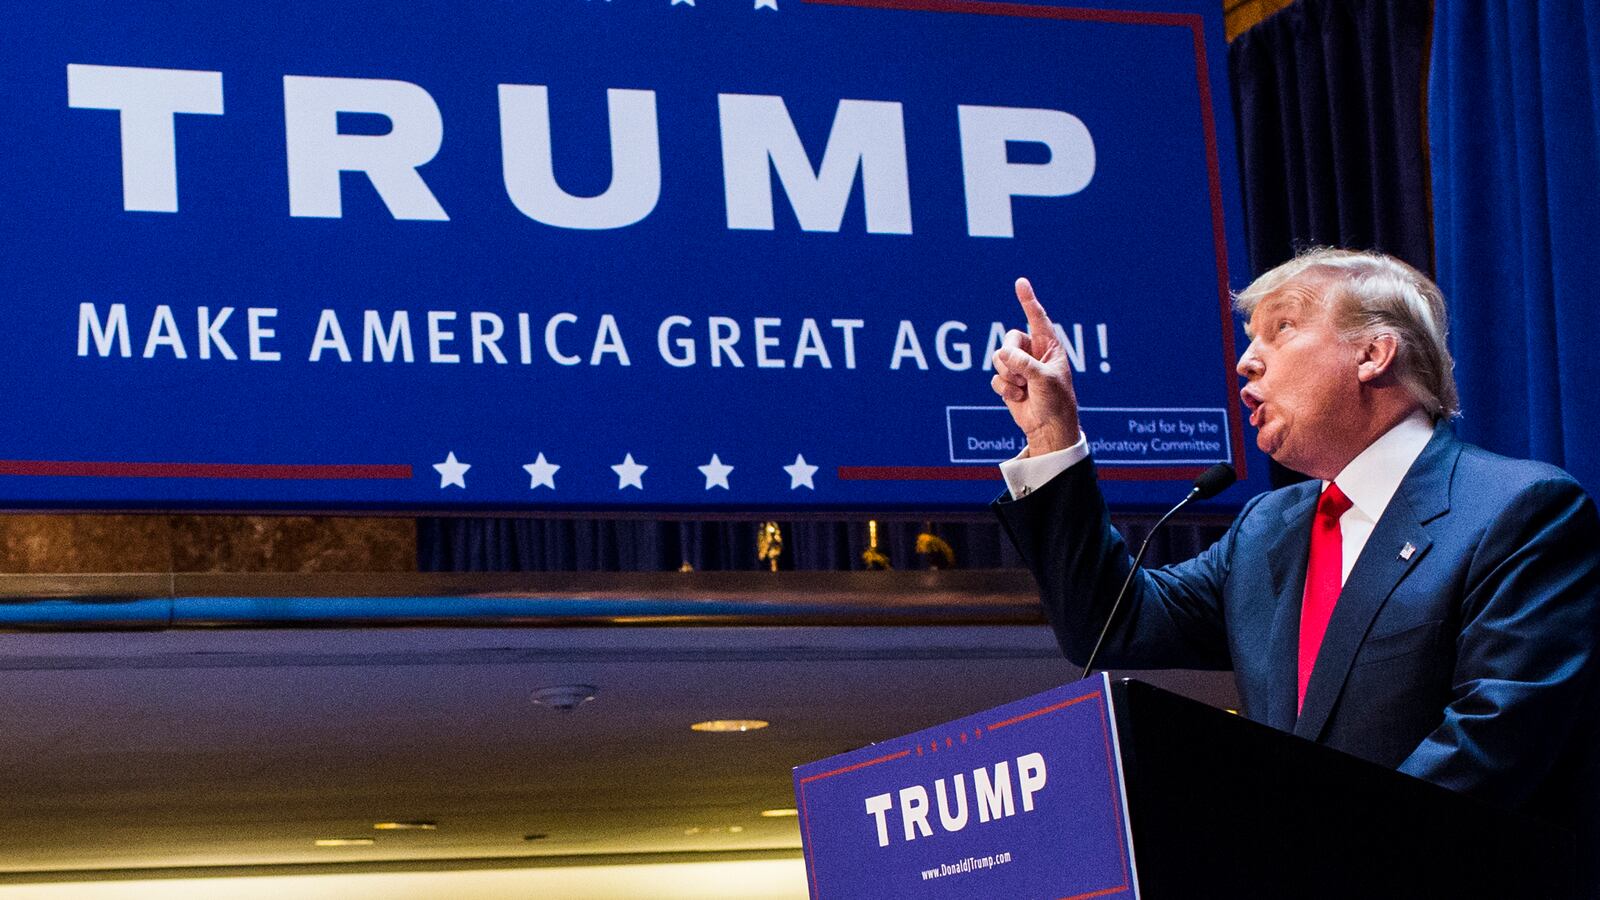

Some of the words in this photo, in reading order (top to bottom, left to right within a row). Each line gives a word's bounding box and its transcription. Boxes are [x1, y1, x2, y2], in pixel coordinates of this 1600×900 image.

[67, 64, 1095, 238] TRUMP
[78, 303, 281, 361] MAKE
[309, 310, 631, 366] AMERICA
[658, 315, 865, 370] GREAT
[891, 320, 1111, 374] AGAN!
[967, 437, 1015, 450] Donald
[1150, 438, 1220, 452] Committee
[1128, 419, 1156, 433] Paid
[1159, 419, 1176, 433] for
[1179, 420, 1195, 436] by
[1198, 421, 1218, 434] the
[865, 752, 1047, 848] TRUMP
[921, 852, 1012, 881] www.DonaldJTrump.com
